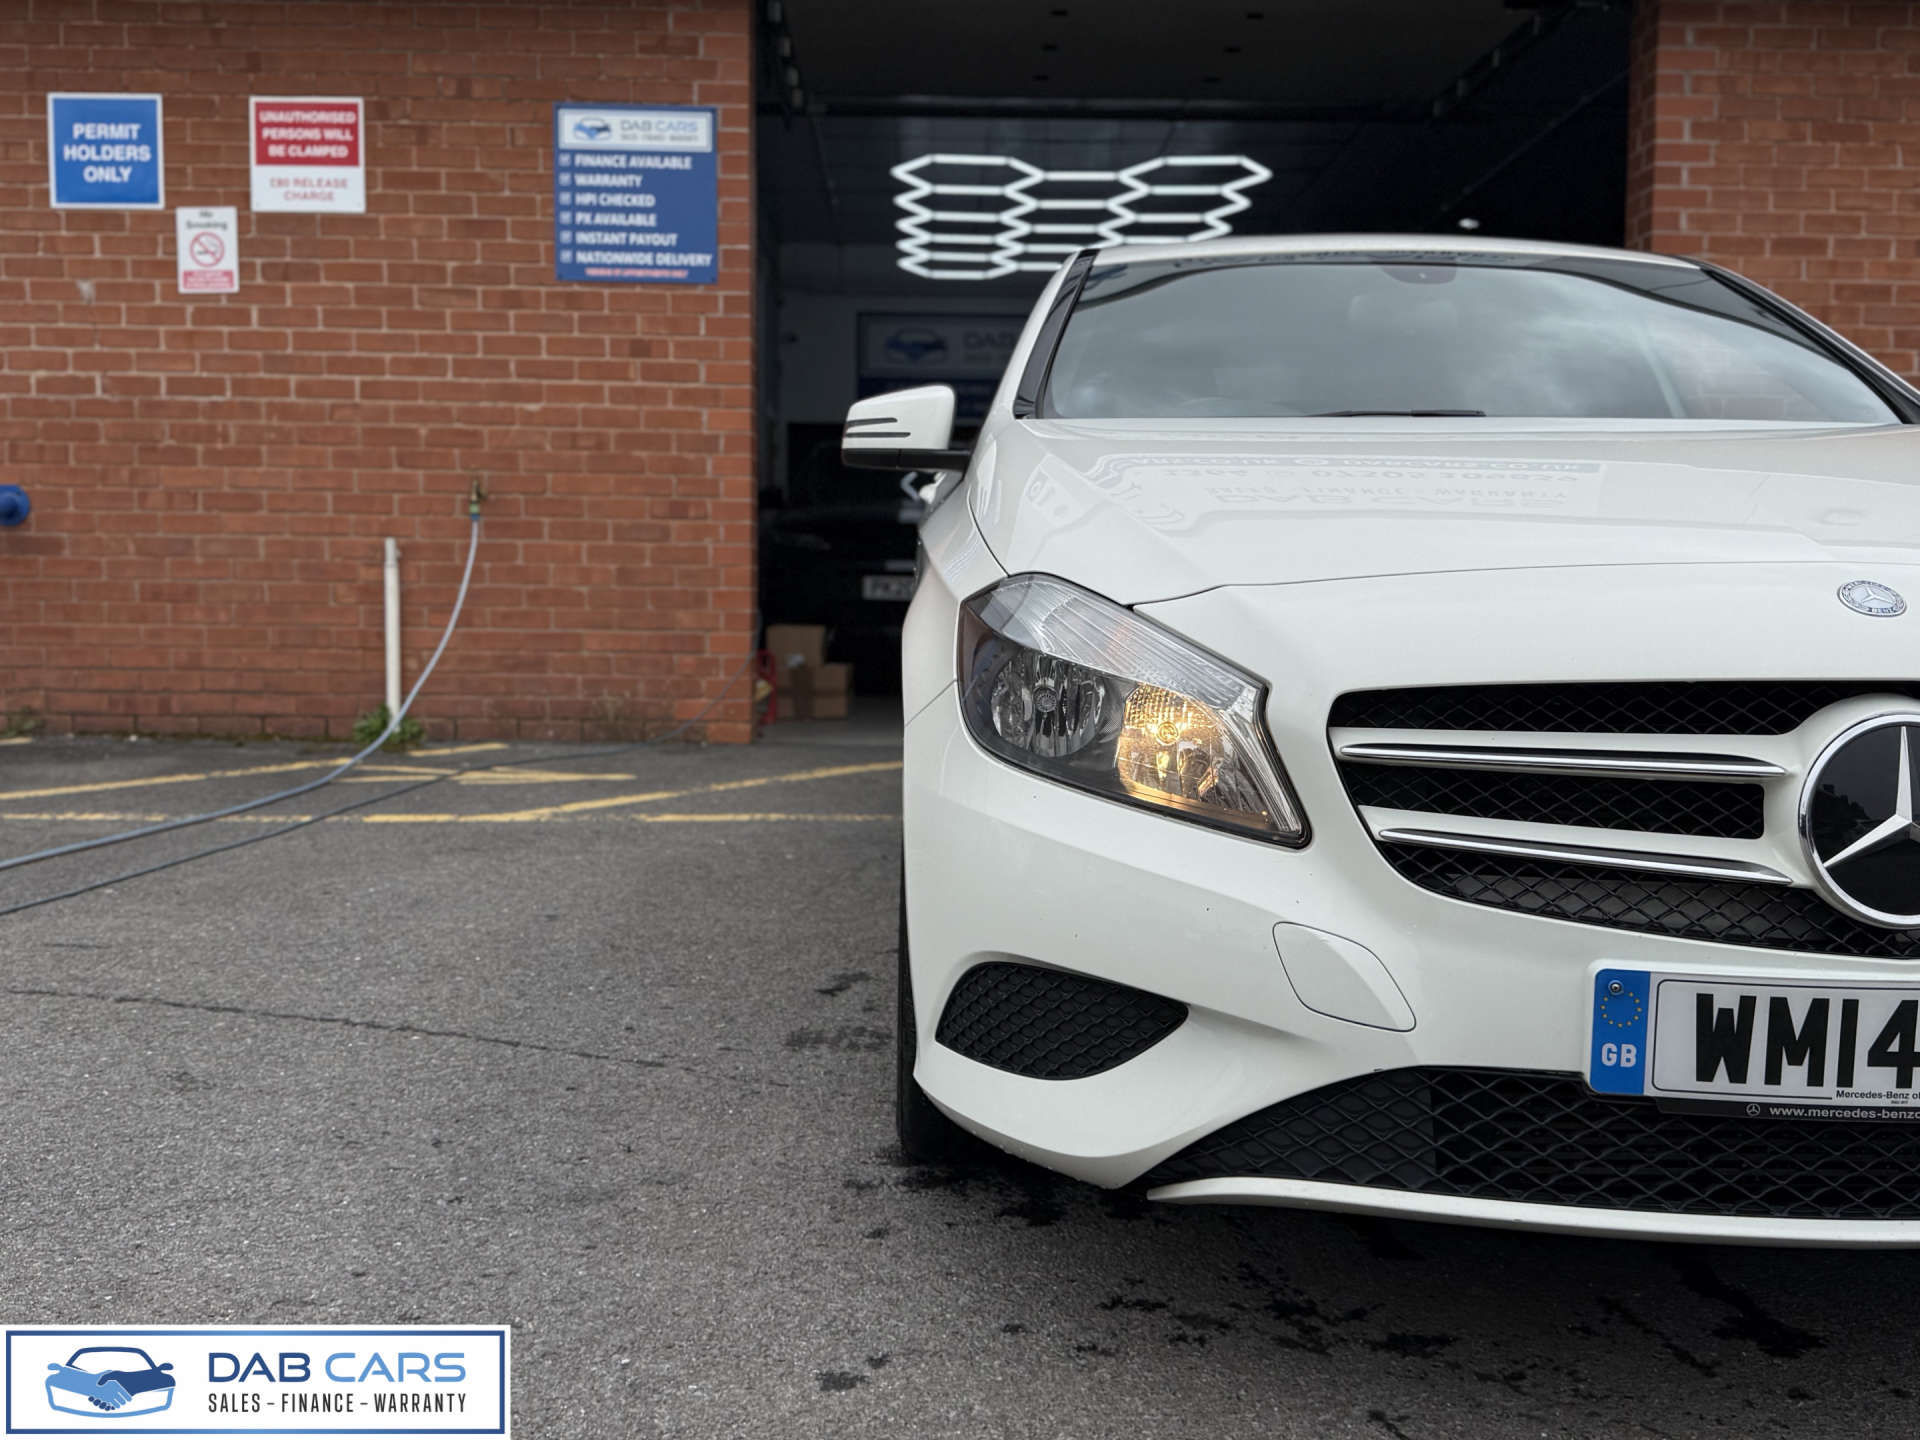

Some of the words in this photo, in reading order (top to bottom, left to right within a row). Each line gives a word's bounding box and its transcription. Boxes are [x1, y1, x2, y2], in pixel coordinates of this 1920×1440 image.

[259, 111, 356, 124] UNAUTHORISED
[73, 123, 141, 140] PERMIT
[654, 120, 698, 133] CARS
[262, 128, 321, 140] PERSONS
[323, 128, 353, 141] WILL
[63, 144, 151, 163] HOLDERS
[268, 145, 285, 157] BE
[287, 145, 349, 158] CLAMPED
[574, 154, 627, 169] FINANCE
[628, 155, 692, 170] AVAILABLE
[83, 166, 132, 183] ONLY
[574, 173, 643, 187] WARRANTY
[293, 178, 347, 189] RELEASE
[283, 190, 334, 201] CHARGE
[599, 193, 656, 207] CHECKED
[593, 213, 657, 227] AVAILABLE
[575, 231, 627, 245] INSTANT
[628, 232, 678, 246] PAYOUT
[575, 251, 653, 265] NATIONWIDE
[656, 252, 712, 267] DELIVERY
[1695, 993, 1920, 1089] WM14
[1602, 1043, 1637, 1068] GB
[1836, 1090, 1909, 1100] Mercedes-Benz
